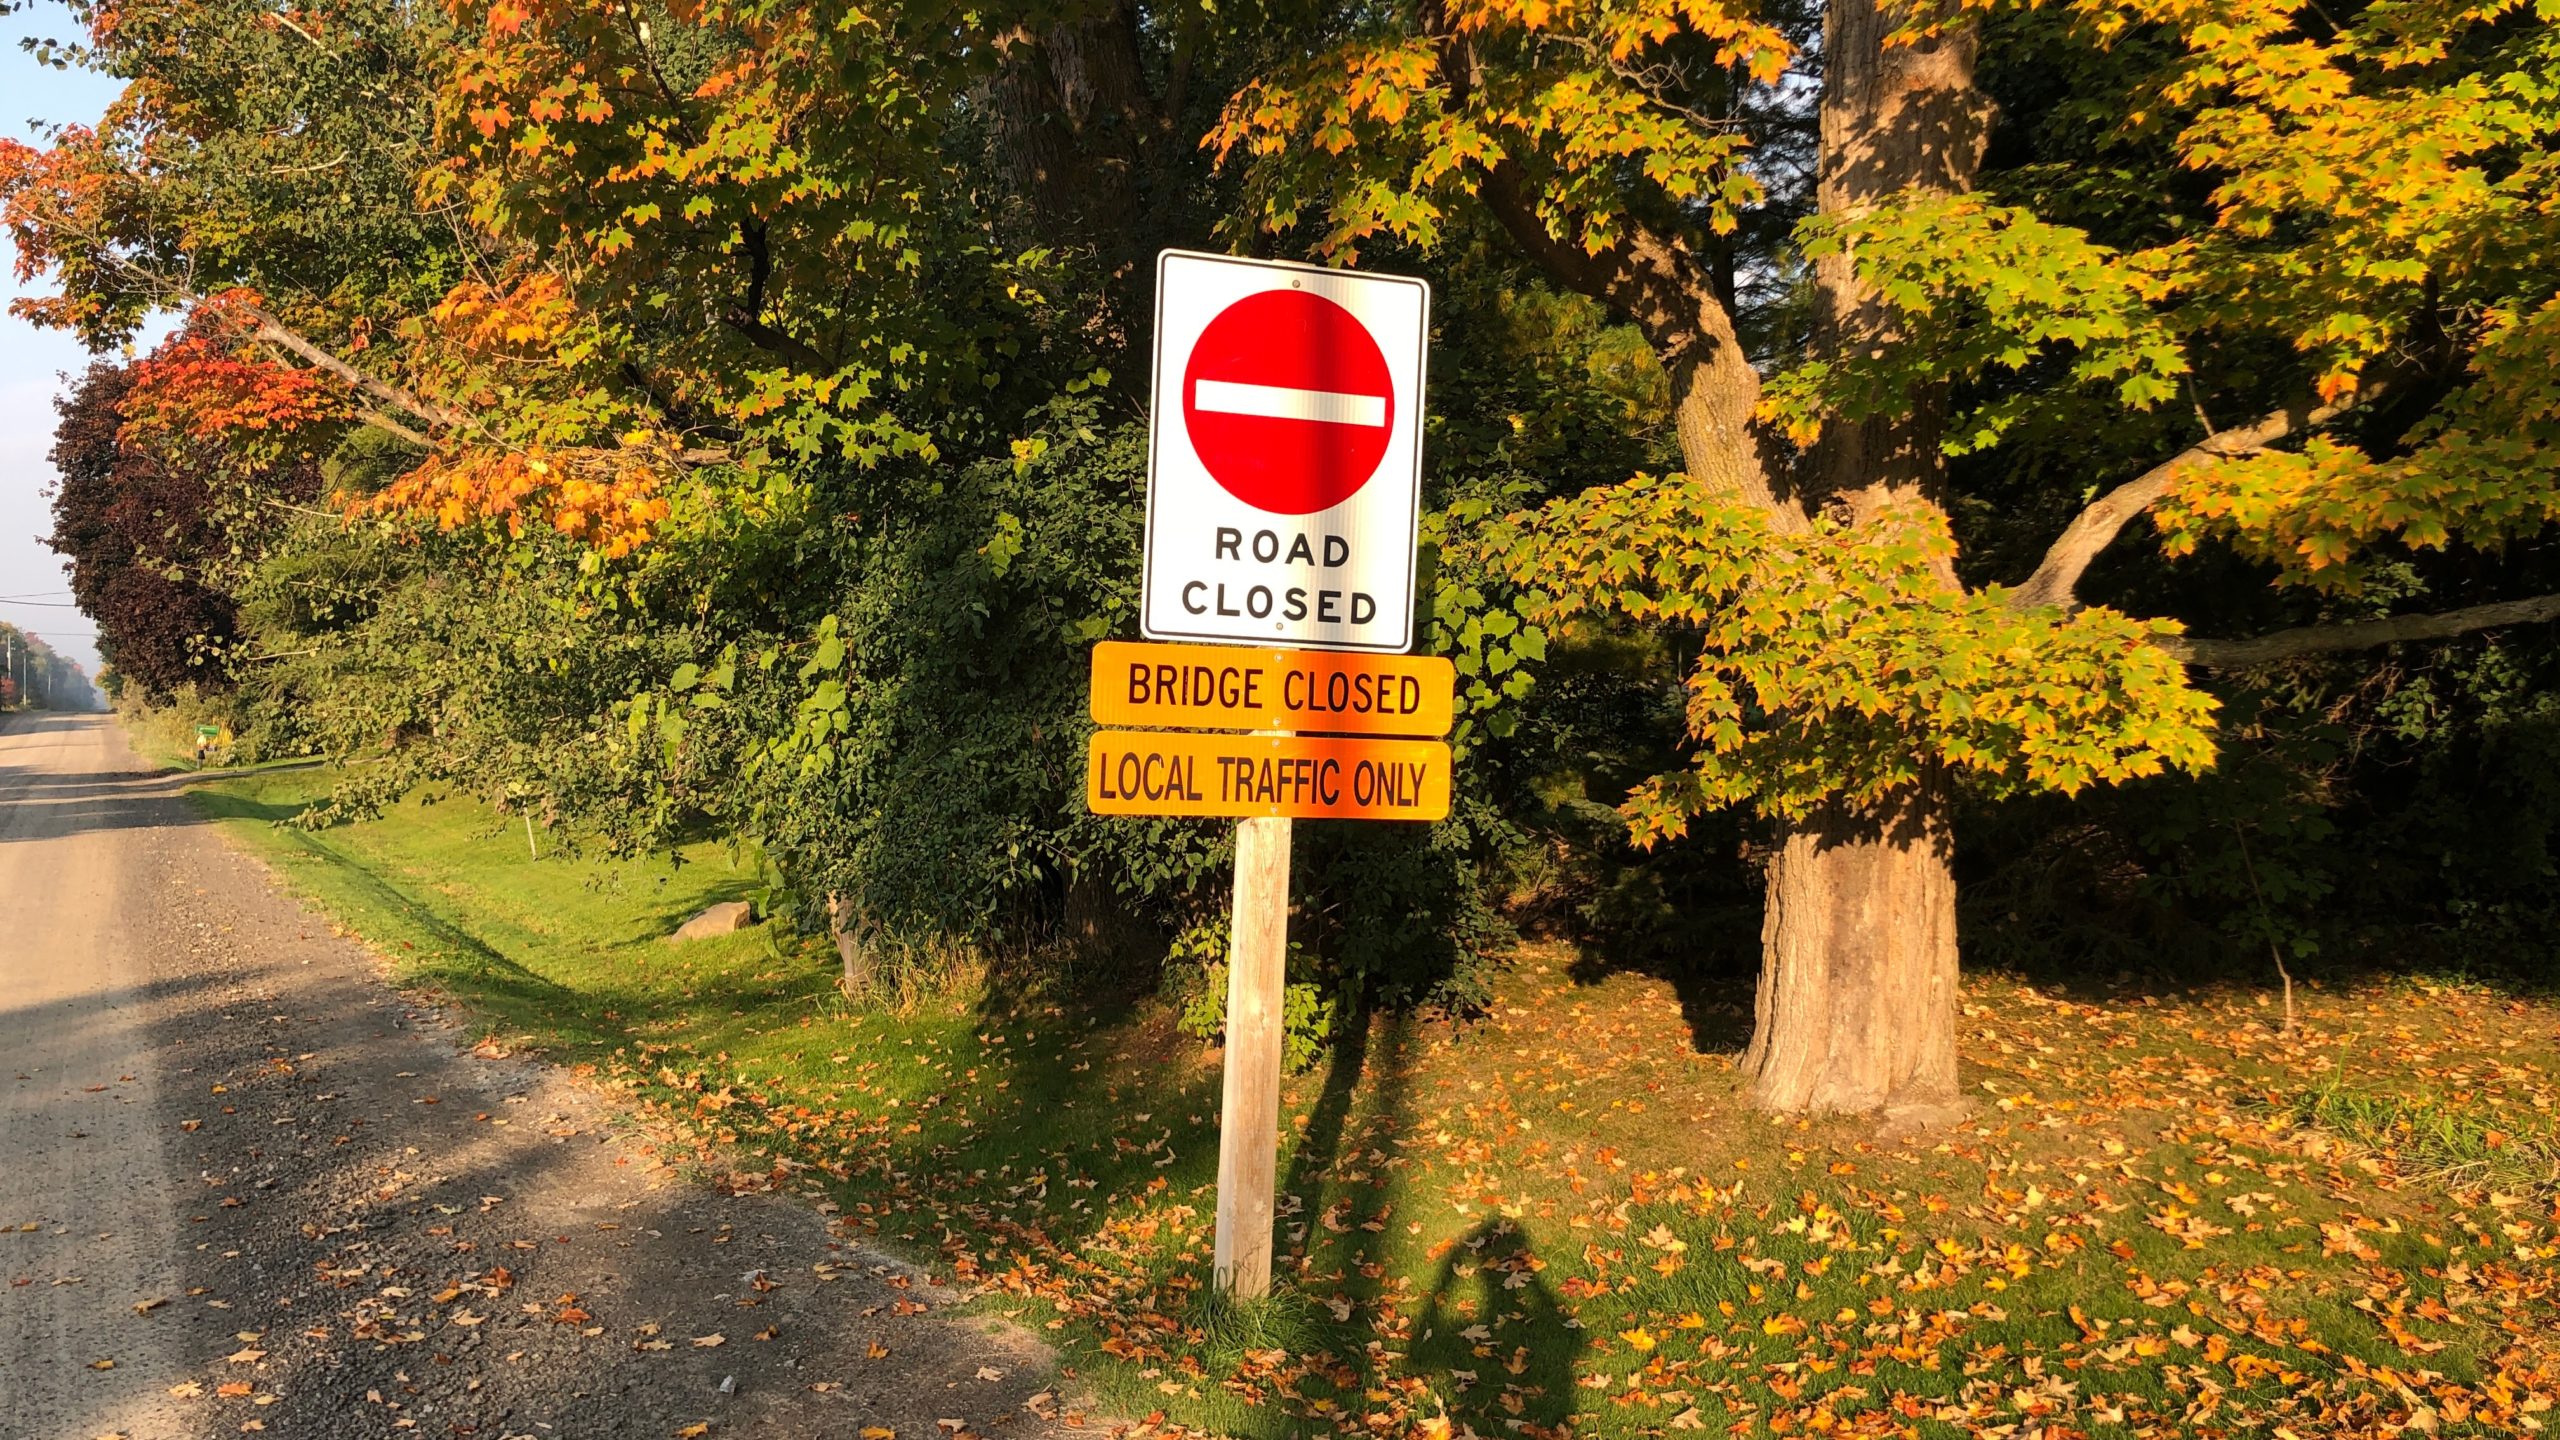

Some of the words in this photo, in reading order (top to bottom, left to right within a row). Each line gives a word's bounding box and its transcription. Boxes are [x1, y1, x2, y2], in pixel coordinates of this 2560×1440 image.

[1215, 527, 1350, 568] ROAD
[1182, 580, 1377, 625] CLOSED
[1128, 663, 1263, 709] BRIDGE
[1284, 670, 1420, 714] CLOSED
[1099, 752, 1203, 801] LOCAL
[1217, 757, 1341, 805] TRAFFIC
[1353, 760, 1427, 807] ONLY
